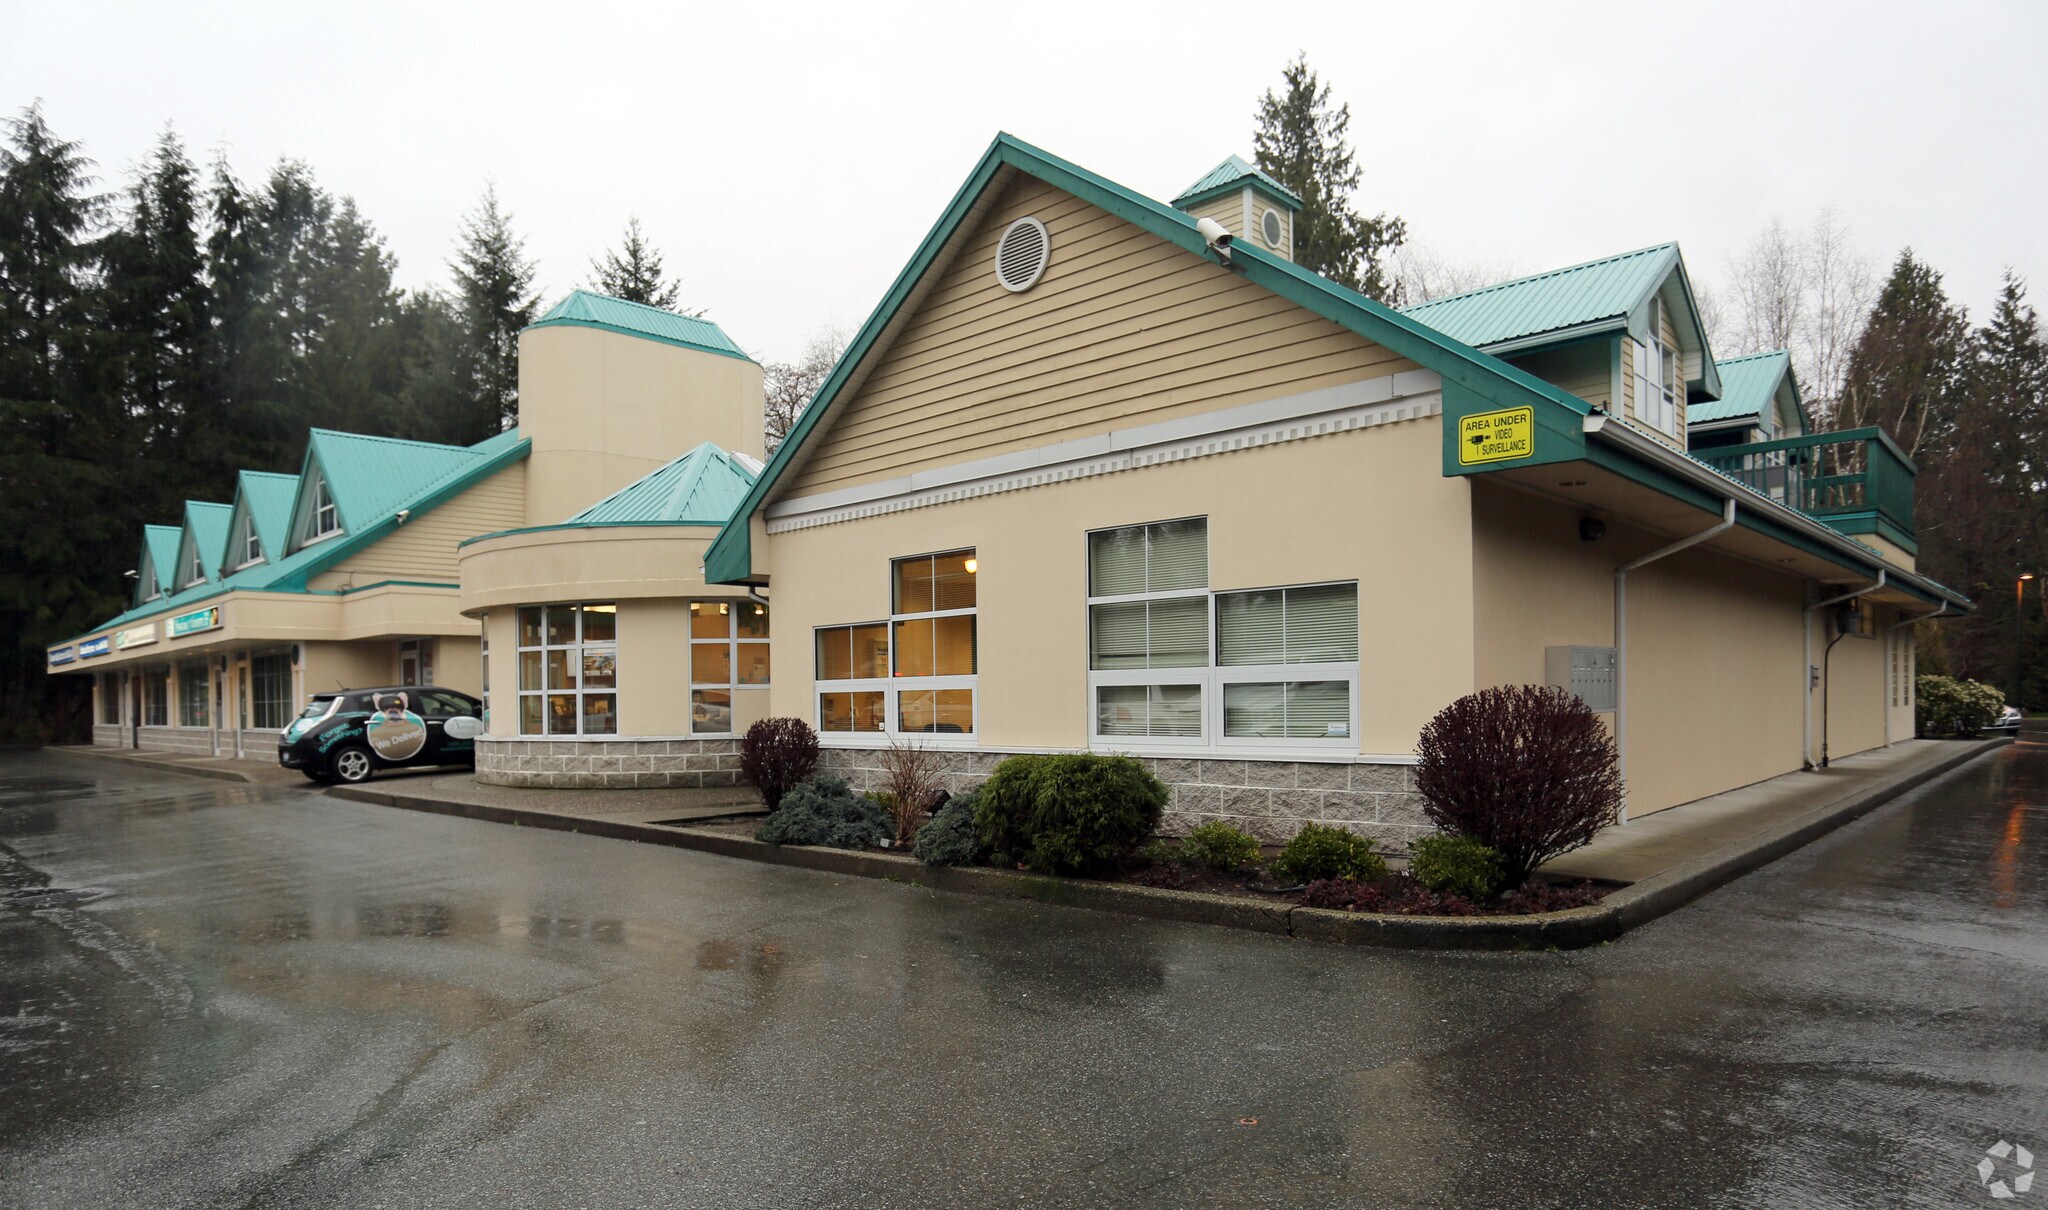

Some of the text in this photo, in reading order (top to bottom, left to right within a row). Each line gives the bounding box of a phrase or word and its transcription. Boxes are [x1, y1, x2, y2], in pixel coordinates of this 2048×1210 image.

[1466, 414, 1527, 431] AREA UNDER
[1494, 428, 1513, 440] VIDEO
[1482, 439, 1526, 455] SURVEILLANCE
[376, 739, 391, 750] We
